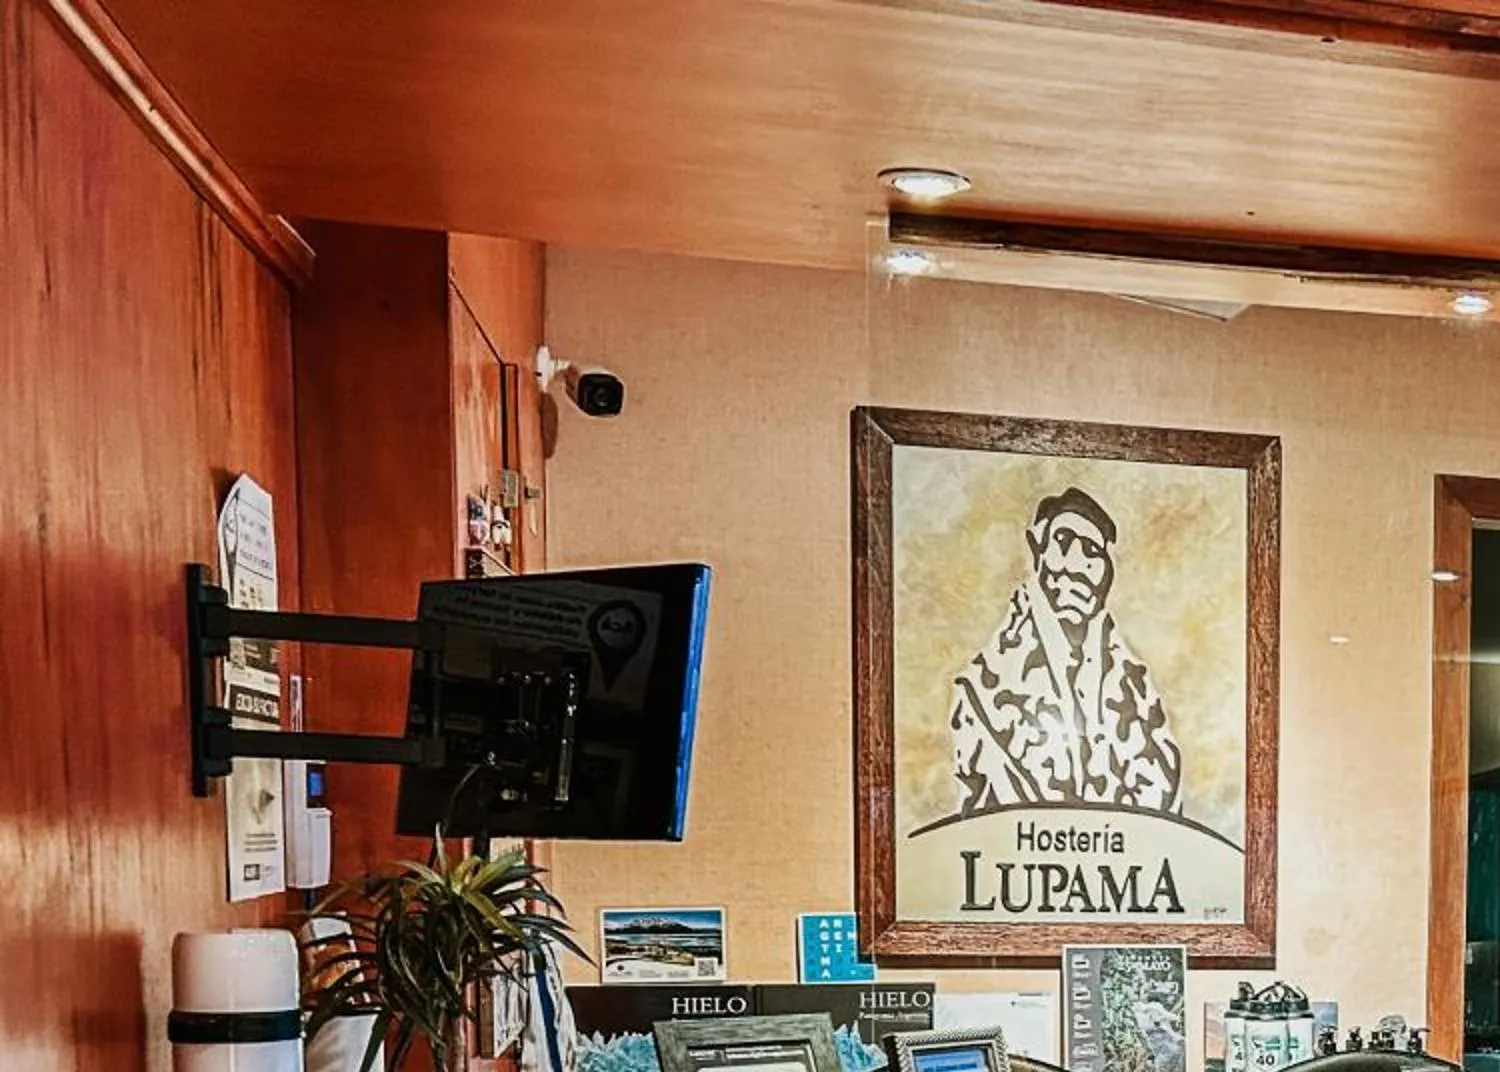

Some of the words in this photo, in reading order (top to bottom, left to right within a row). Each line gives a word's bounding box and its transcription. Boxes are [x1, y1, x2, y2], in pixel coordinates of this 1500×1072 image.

[1017, 822, 1125, 854] Hostería
[960, 851, 1185, 915] LUPAMA
[671, 996, 747, 1015] HIELO
[859, 991, 931, 1009] HIELO
